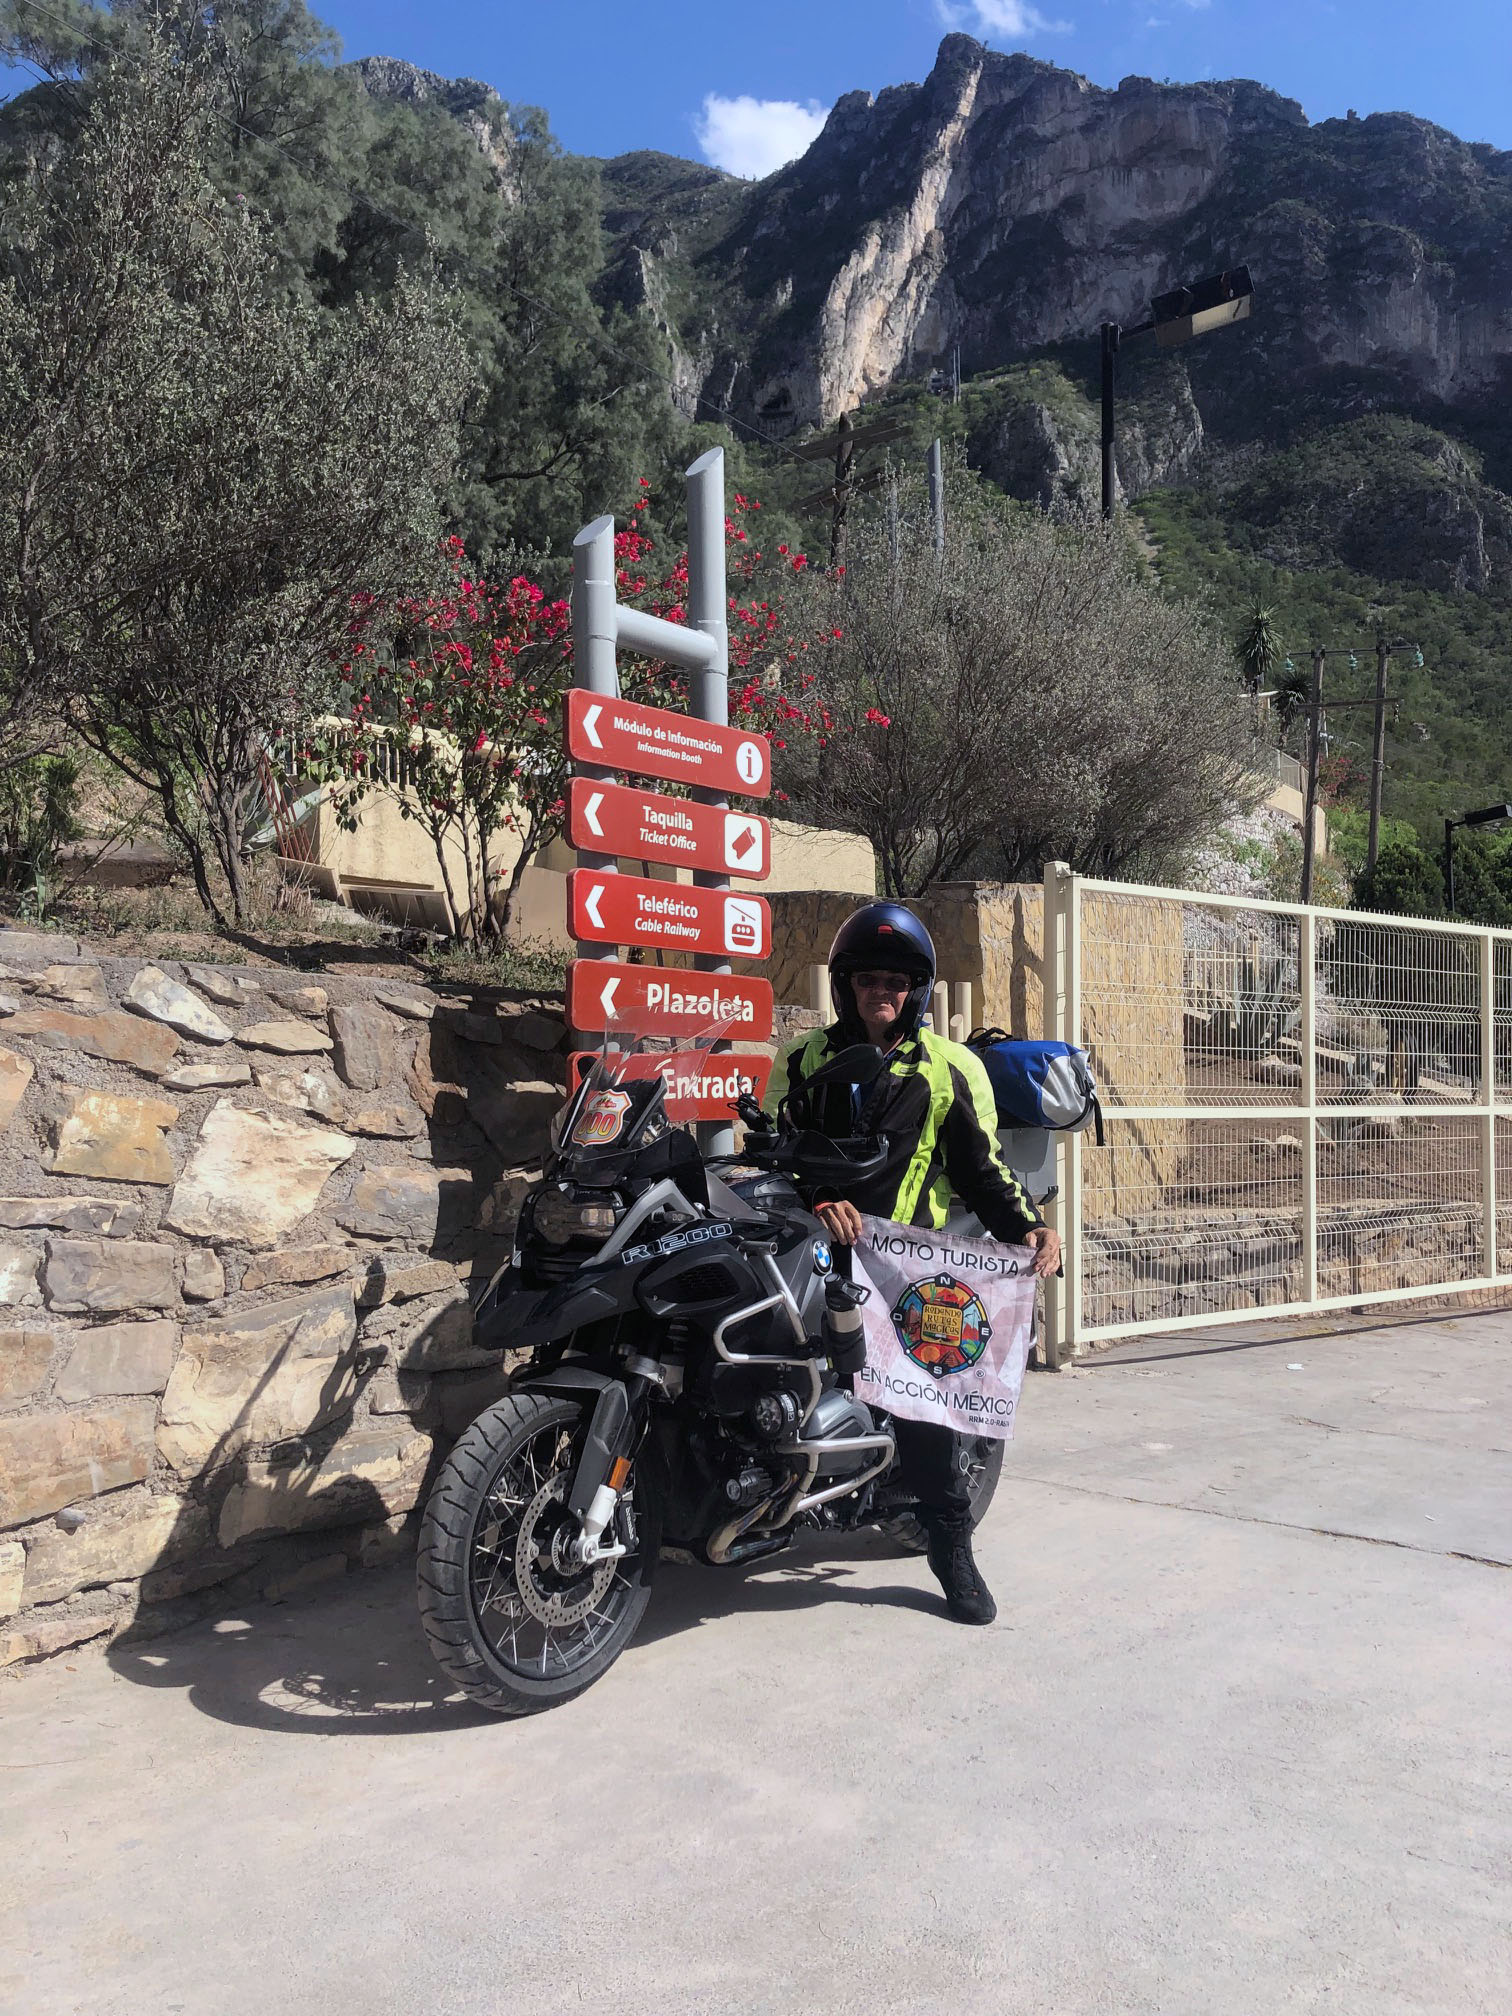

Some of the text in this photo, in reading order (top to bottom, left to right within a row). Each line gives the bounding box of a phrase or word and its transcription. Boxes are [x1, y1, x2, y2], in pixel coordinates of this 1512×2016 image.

[613, 715, 723, 755] Módulo de Información
[637, 741, 703, 765] Information Booth
[642, 805, 693, 831] Taquilla
[640, 828, 697, 851] Ticket Office
[637, 894, 699, 919] Teleférico
[634, 917, 701, 941] Cable Railway
[647, 983, 754, 1022] Plazoleta
[662, 1067, 752, 1099] Entrada
[871, 1232, 1019, 1276] MOTO TURISTA
[940, 1276, 951, 1285] N
[981, 1327, 990, 1336] E
[933, 1365, 943, 1375] S
[860, 1366, 1014, 1416] EN ACCIÓN MÉXICO
